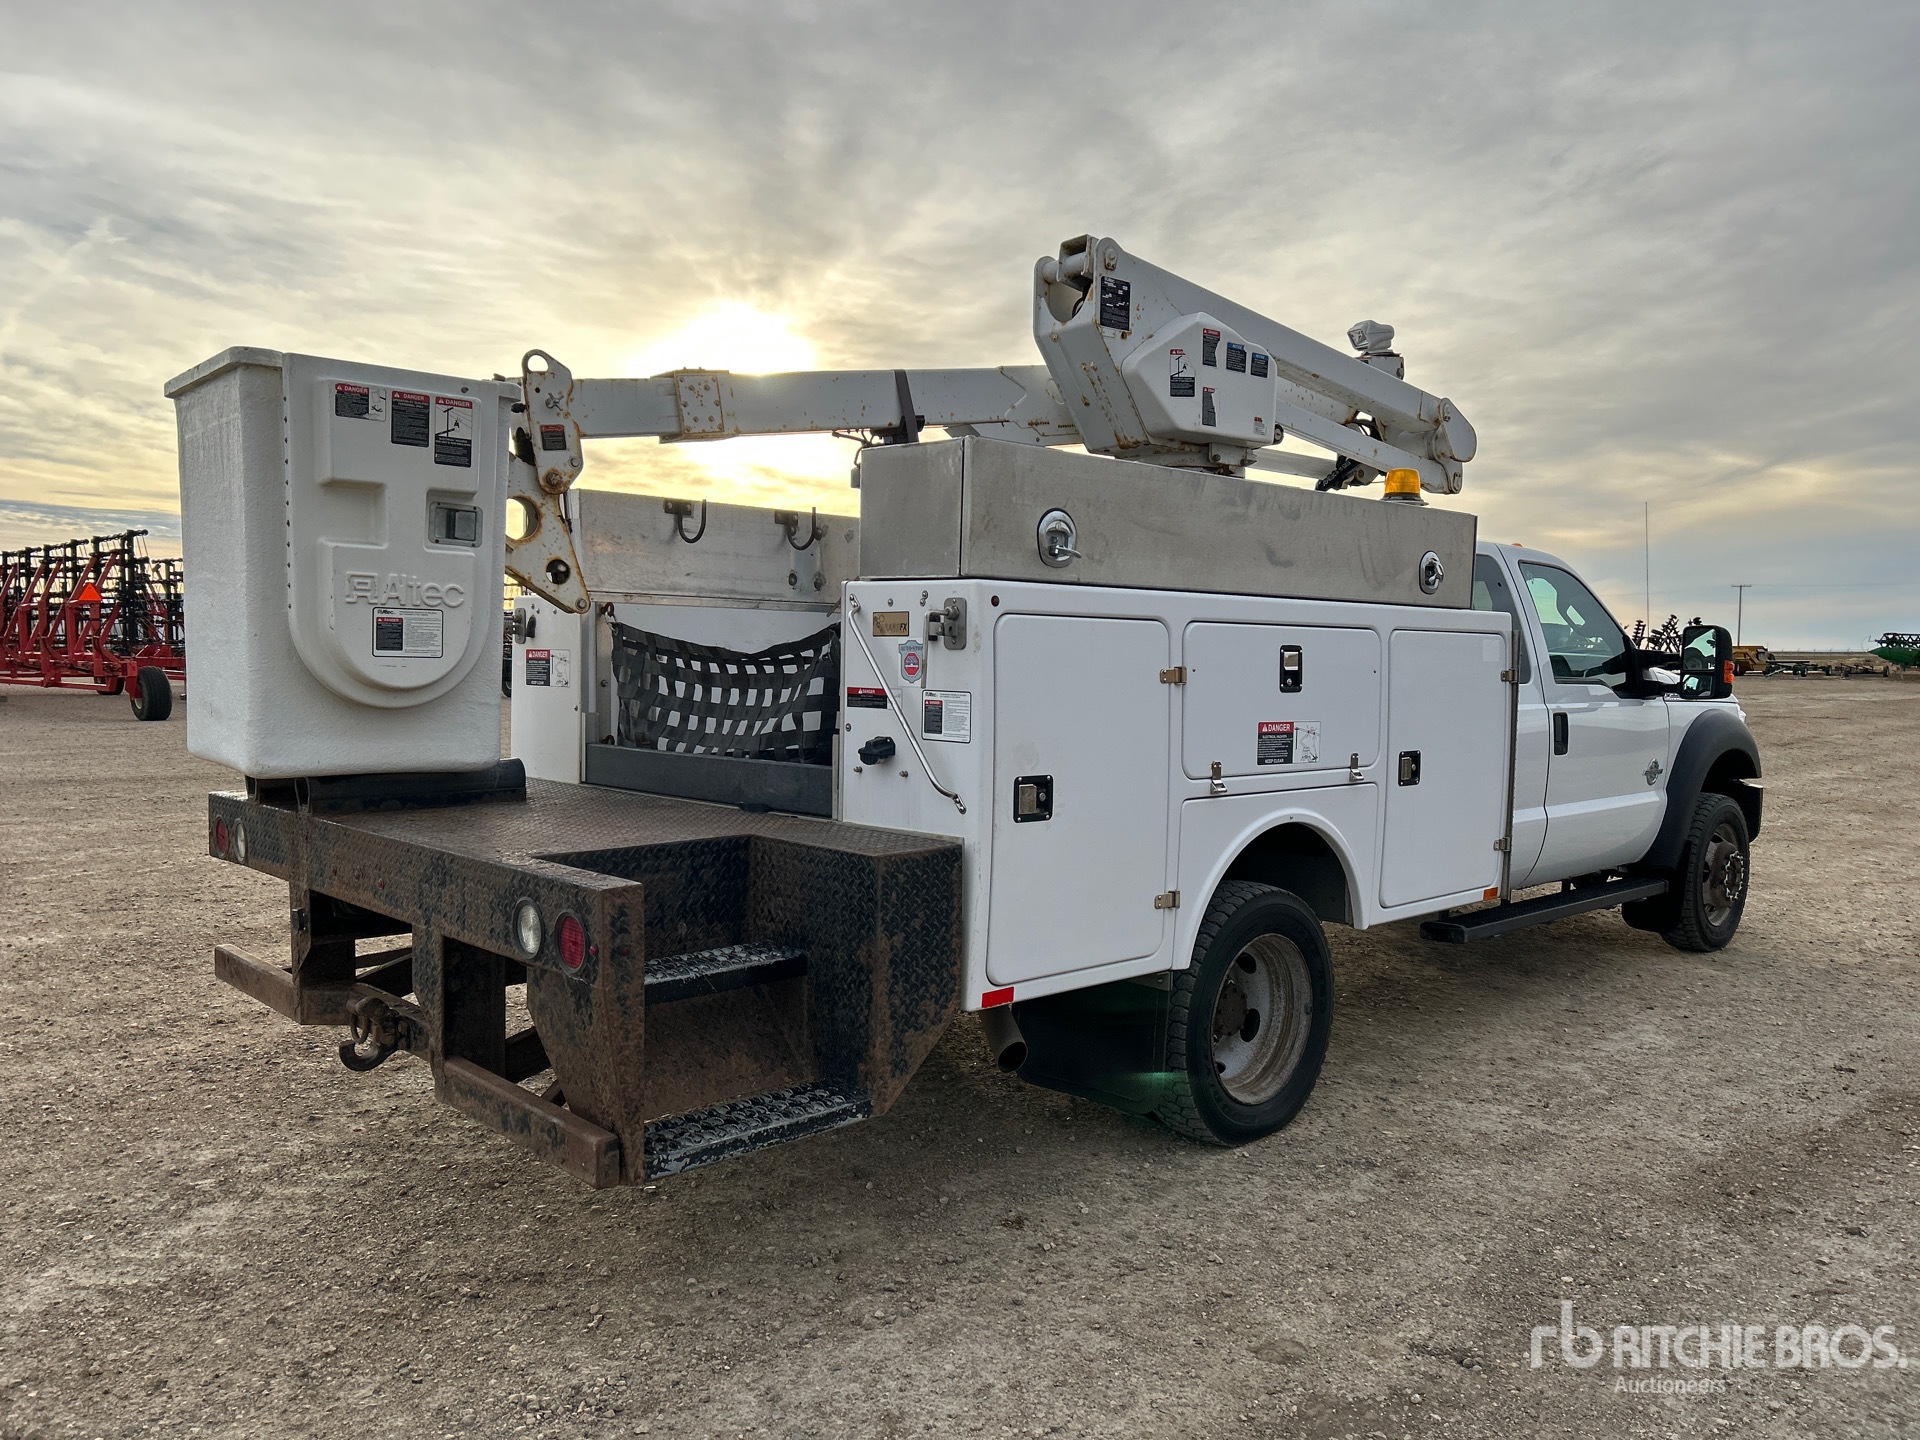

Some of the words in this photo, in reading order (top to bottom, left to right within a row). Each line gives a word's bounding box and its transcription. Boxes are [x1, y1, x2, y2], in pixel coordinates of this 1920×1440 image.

[344, 385, 368, 394] DANGER
[403, 393, 425, 401] DANGER
[445, 399, 470, 407] DANGER
[381, 573, 464, 608] Altec
